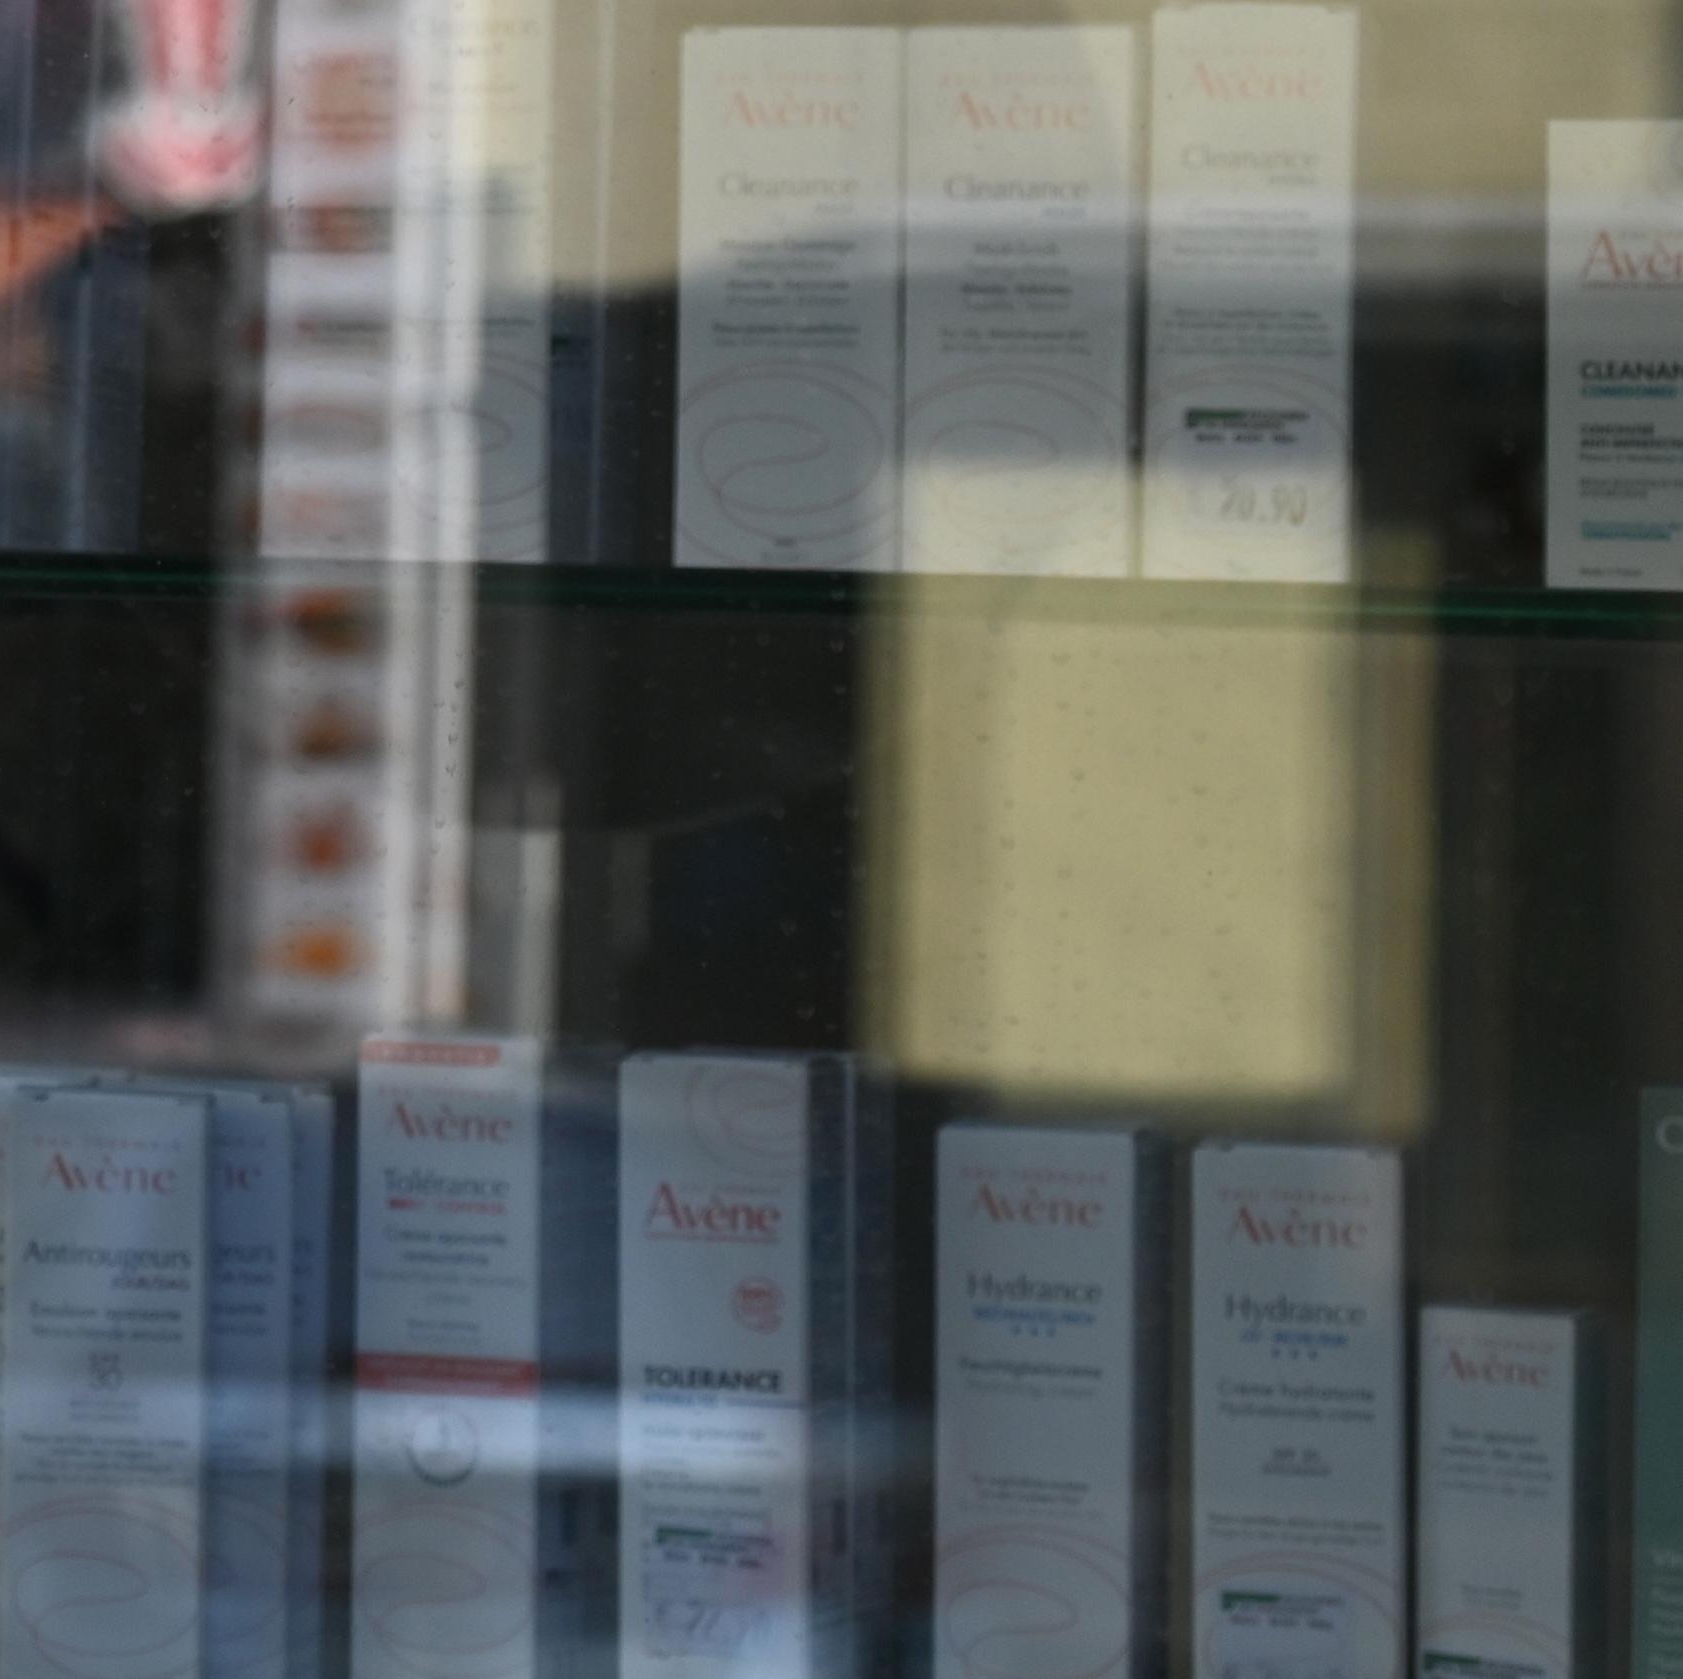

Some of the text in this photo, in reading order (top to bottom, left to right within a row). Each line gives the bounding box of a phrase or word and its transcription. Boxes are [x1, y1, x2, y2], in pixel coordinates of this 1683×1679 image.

[387, 1102, 513, 1145] Avène
[41, 1150, 178, 1196] Avène
[643, 1181, 782, 1232] Avène
[969, 1182, 1104, 1230] Avène
[1225, 1205, 1368, 1249] Avène
